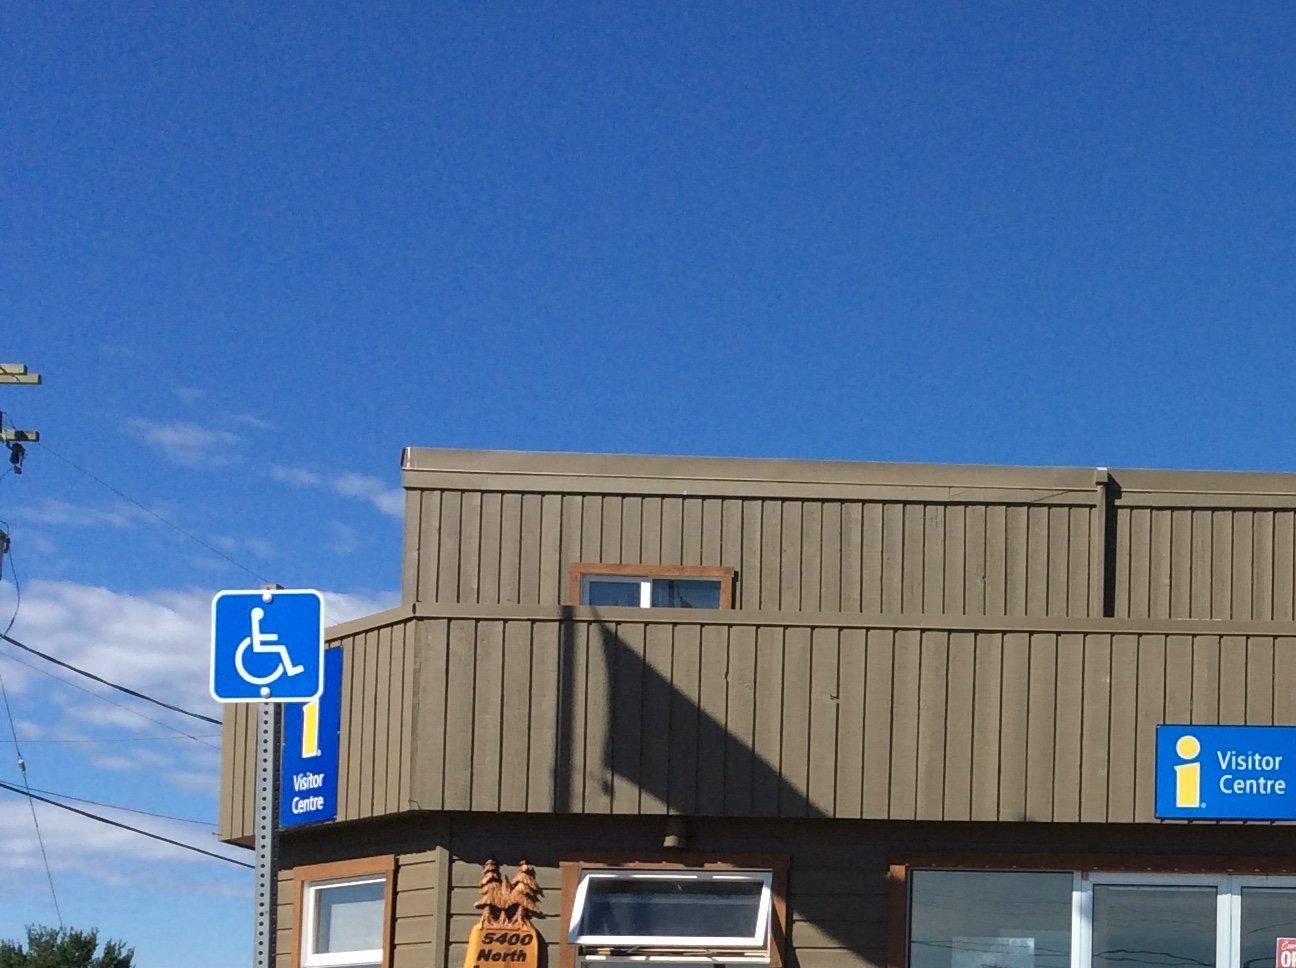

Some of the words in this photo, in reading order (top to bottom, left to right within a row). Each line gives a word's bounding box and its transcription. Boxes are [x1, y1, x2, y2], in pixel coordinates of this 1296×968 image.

[1217, 750, 1283, 771] Visitor
[293, 772, 324, 792] Visitor
[1219, 775, 1286, 794] Centre
[291, 796, 324, 814] Centre
[482, 932, 534, 946] 5400
[477, 949, 527, 962] North
